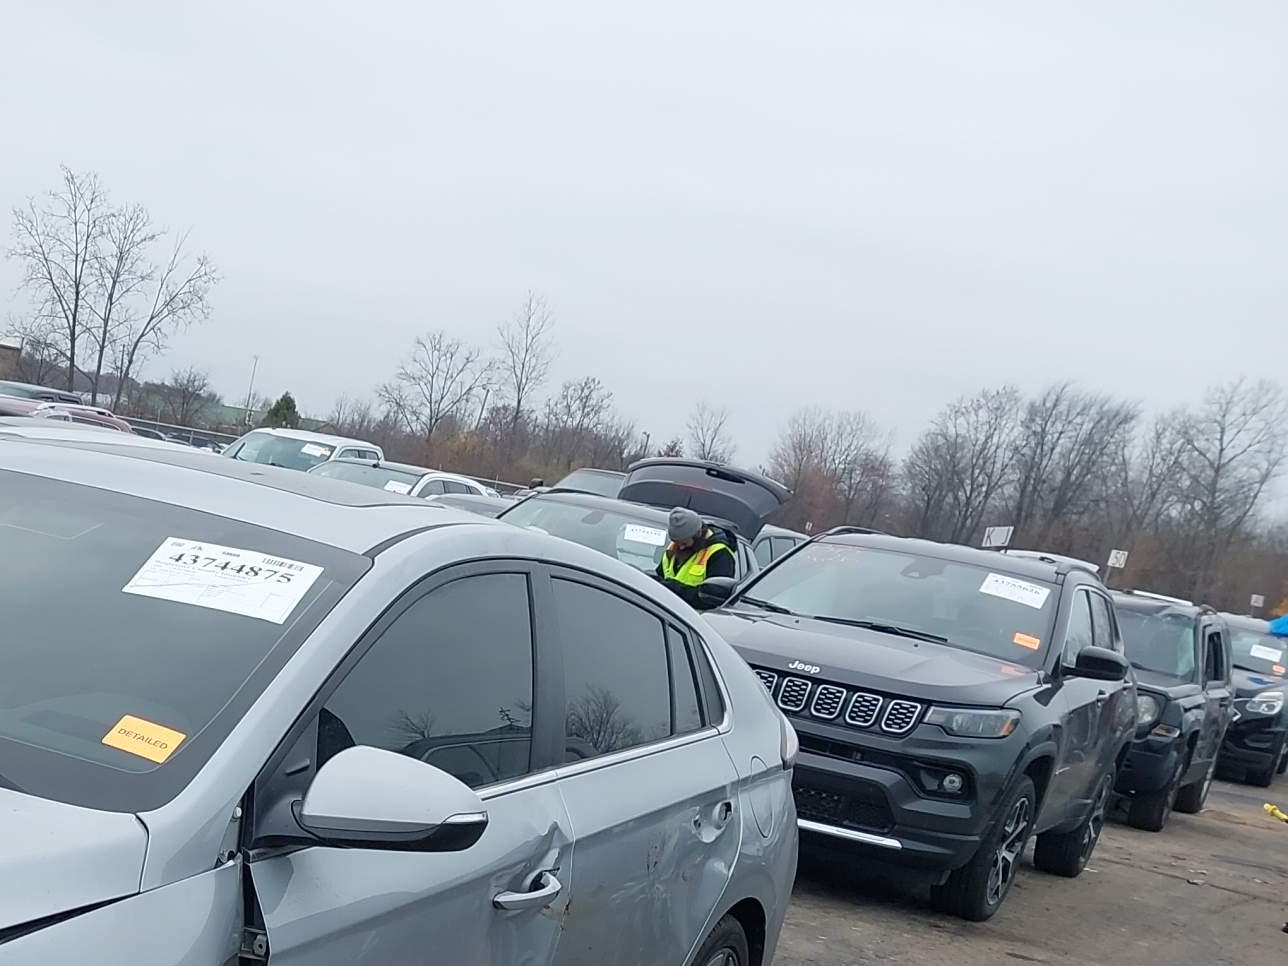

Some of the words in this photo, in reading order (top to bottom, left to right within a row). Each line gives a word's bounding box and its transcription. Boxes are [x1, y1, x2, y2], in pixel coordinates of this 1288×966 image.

[169, 552, 295, 583] 43744875
[788, 660, 821, 674] Jeep
[117, 727, 169, 751] DETAILED
